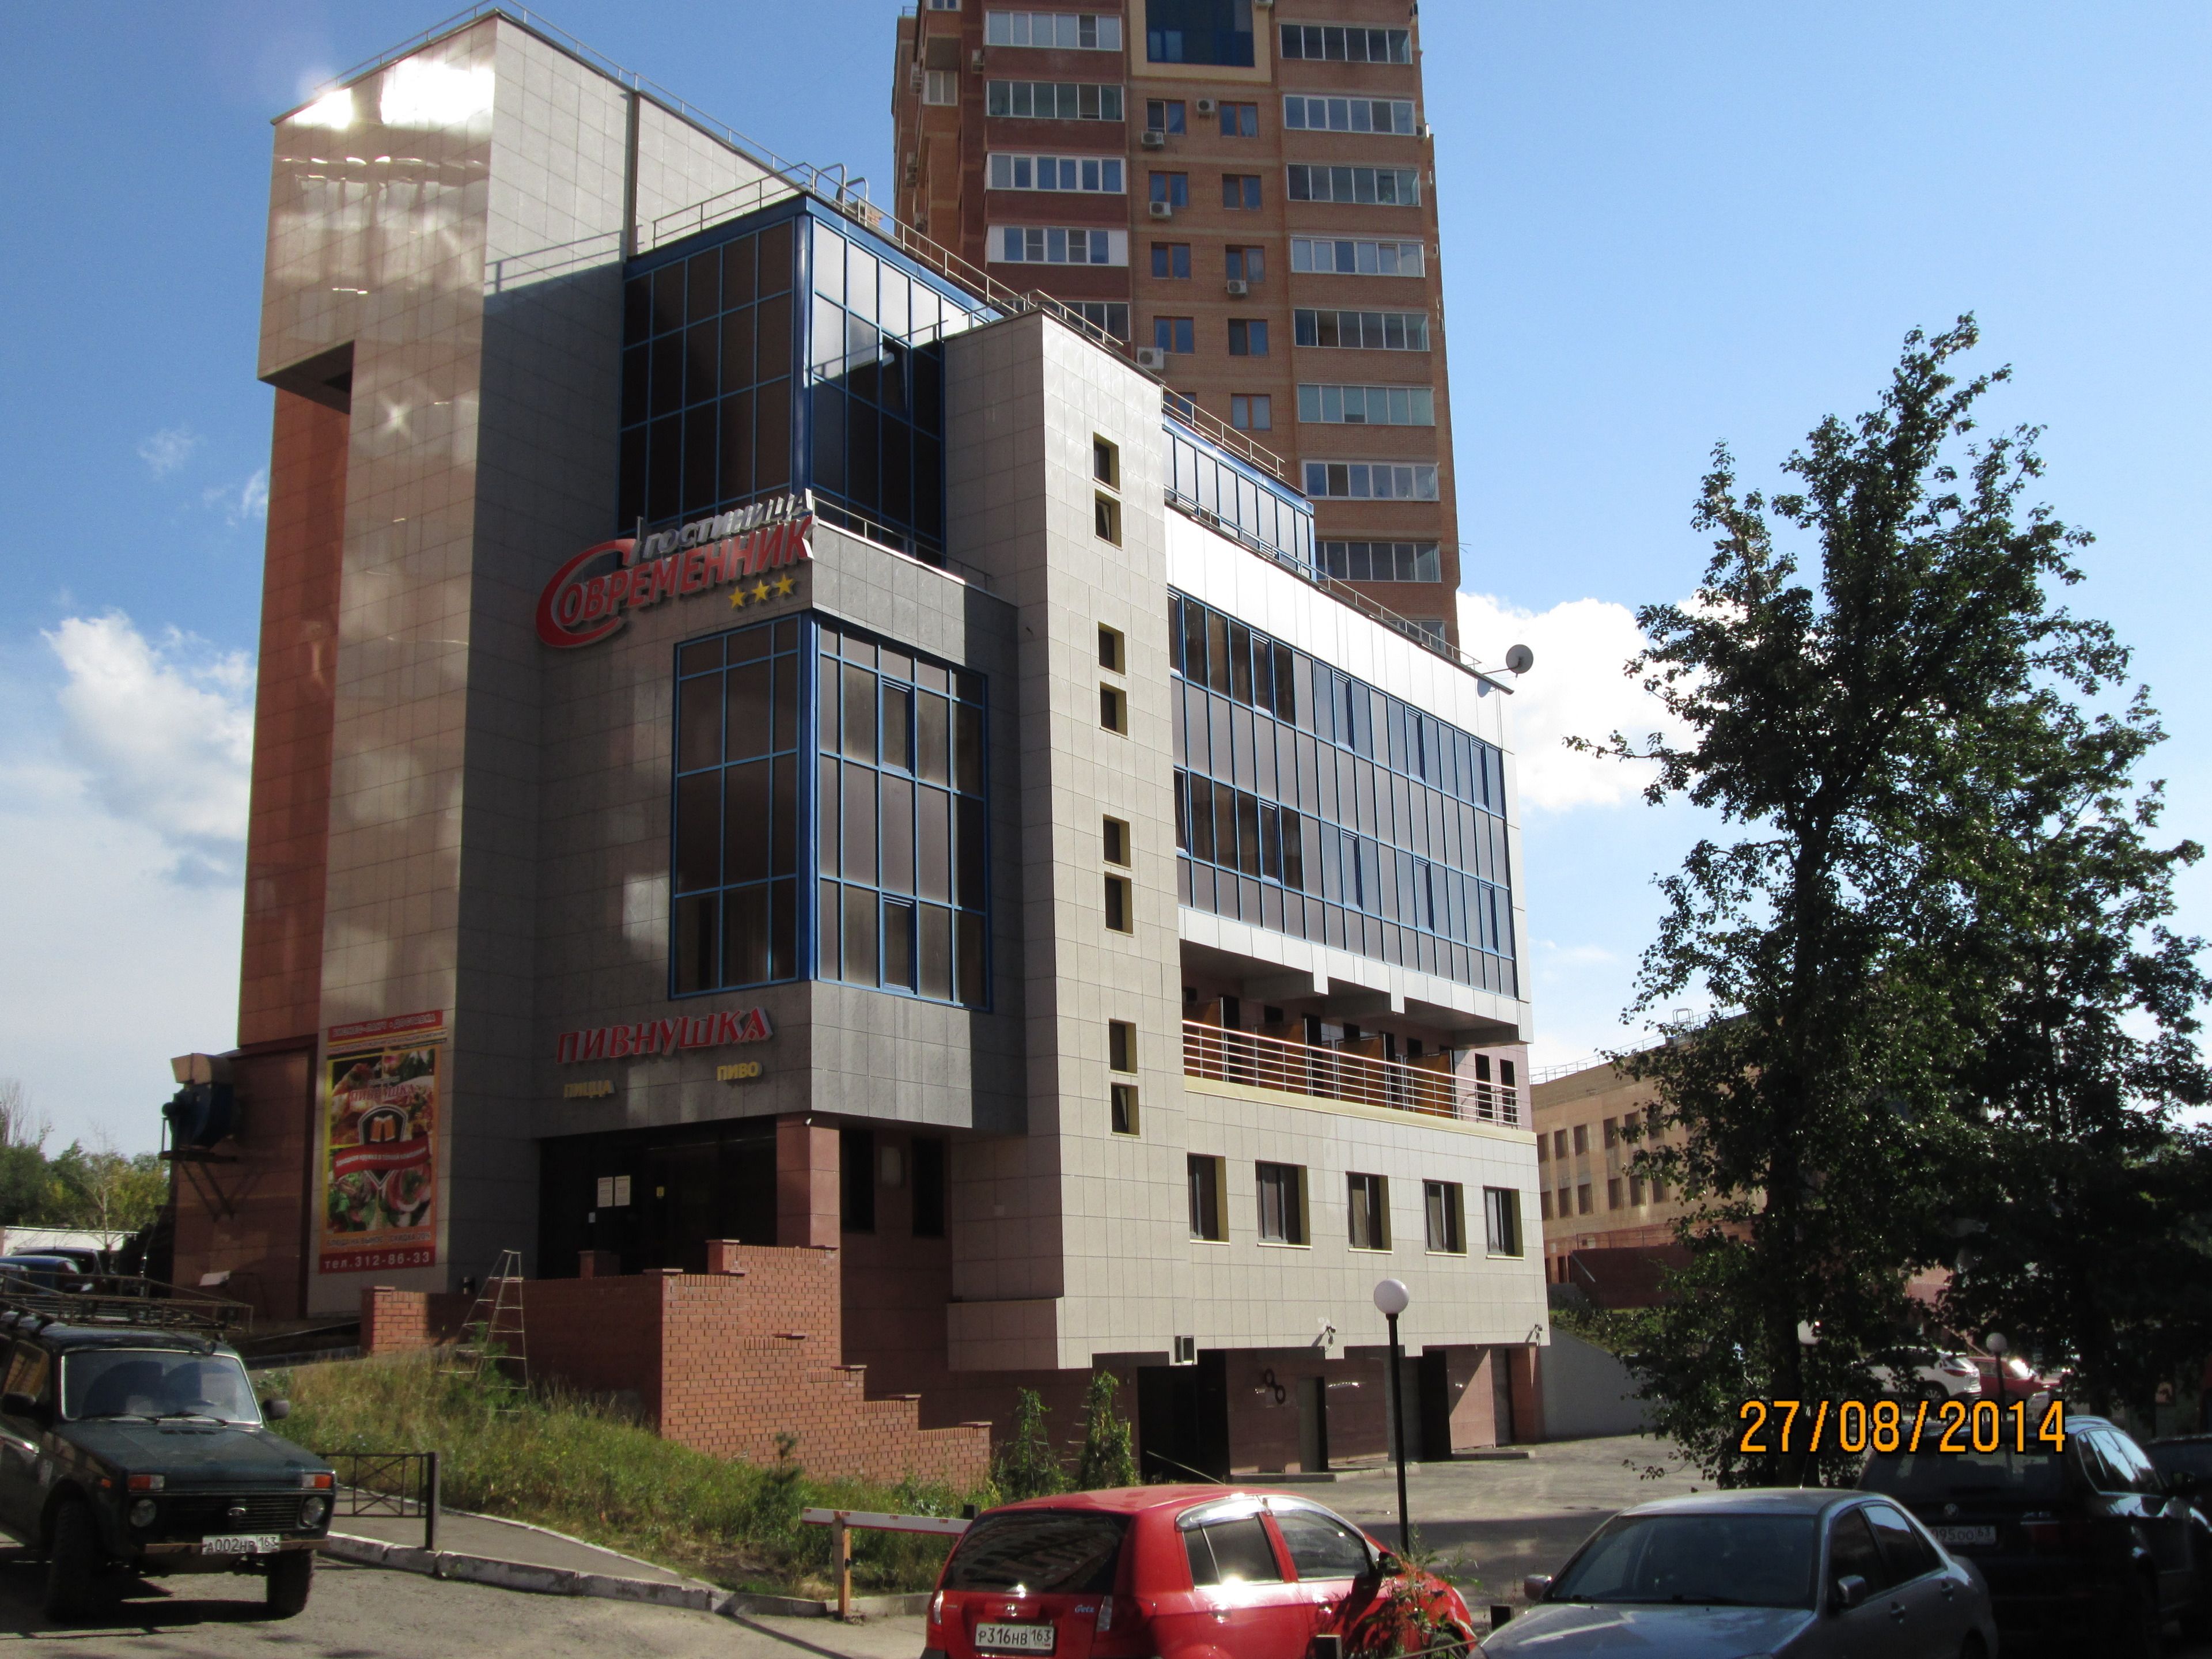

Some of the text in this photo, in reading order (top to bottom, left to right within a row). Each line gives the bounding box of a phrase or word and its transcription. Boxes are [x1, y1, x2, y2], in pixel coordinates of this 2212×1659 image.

[642, 488, 813, 559] ГОСТИНИЦА
[536, 514, 816, 648] СОВРЕМЕННИК
[557, 1006, 773, 1064] ПИВНУШКА
[563, 1080, 615, 1099] ПИЦЦА
[717, 1061, 762, 1081] ПИВО
[1031, 1629, 1051, 1642] 163
